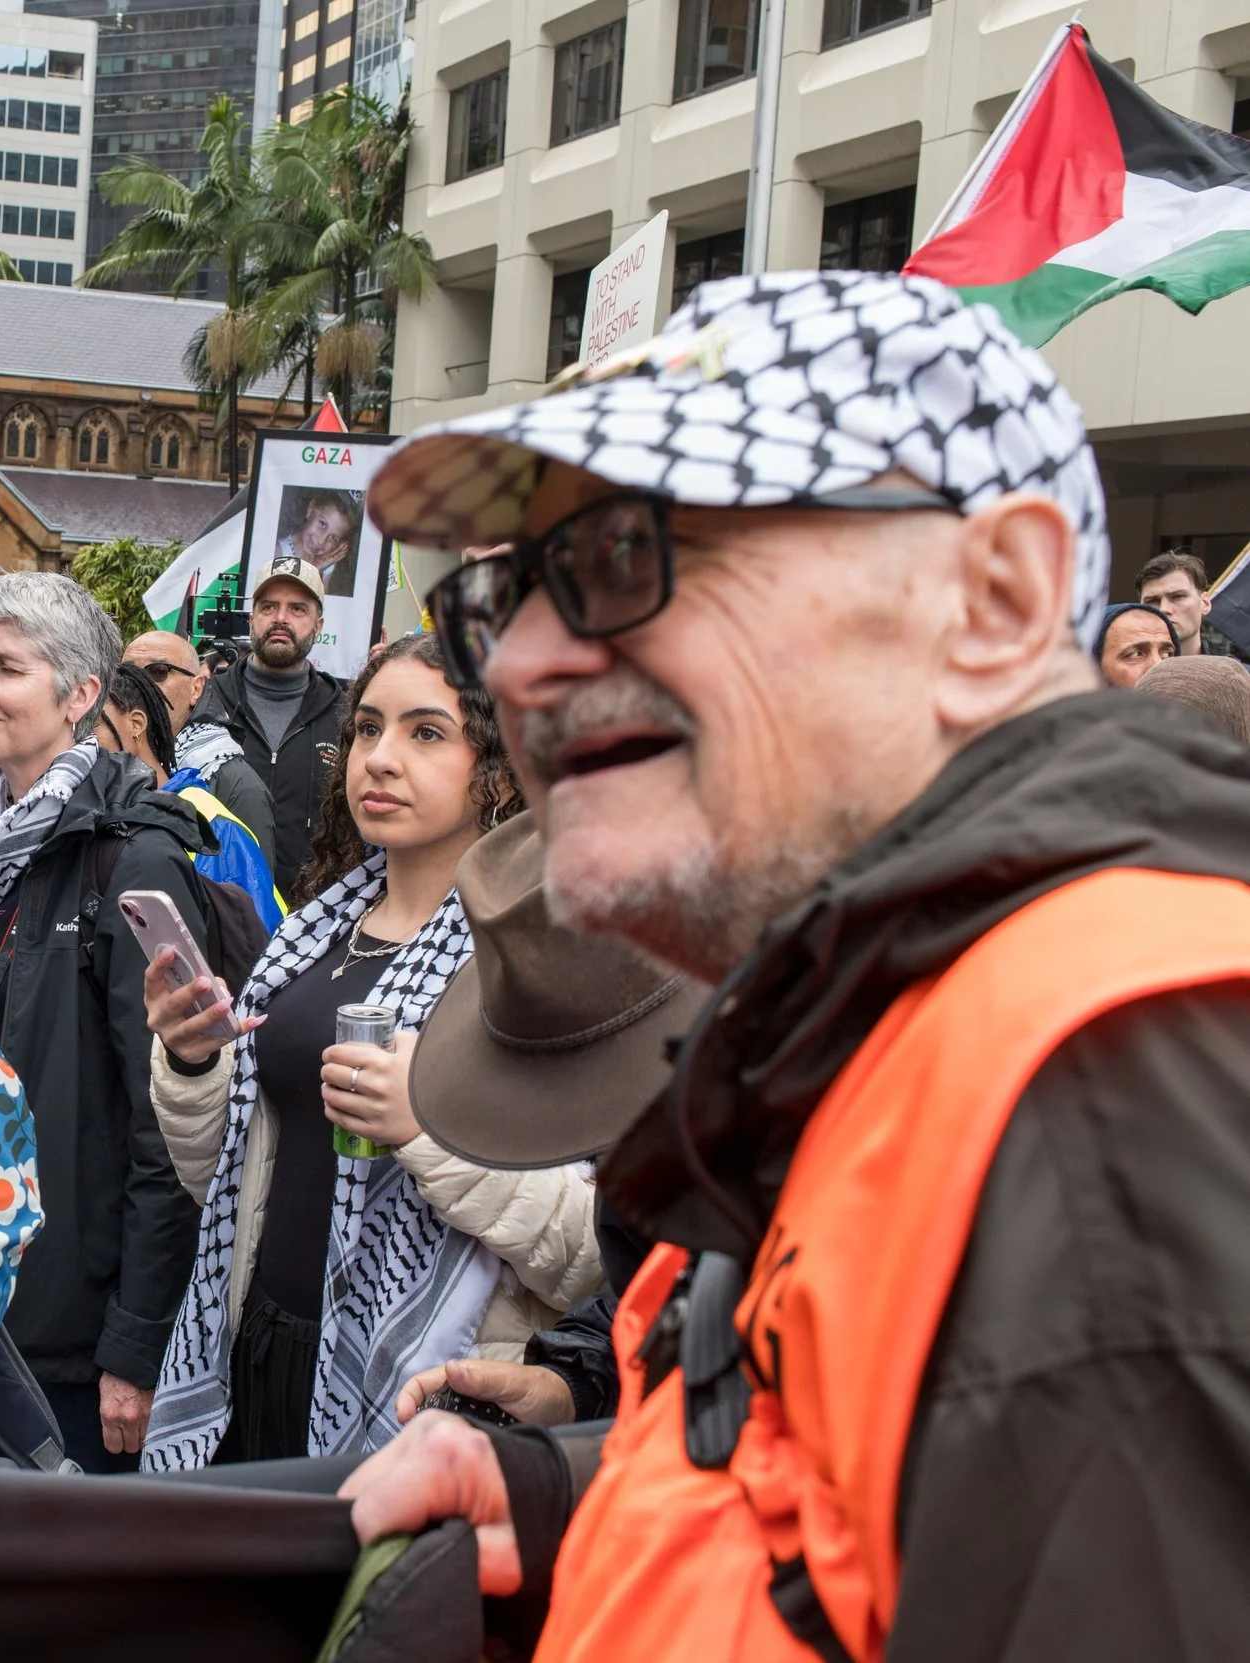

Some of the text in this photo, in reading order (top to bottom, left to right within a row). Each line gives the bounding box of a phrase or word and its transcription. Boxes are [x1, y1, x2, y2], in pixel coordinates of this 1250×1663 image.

[595, 244, 646, 302] TO STAND
[587, 300, 641, 360] PALESTINE
[591, 292, 617, 331] WITH
[301, 446, 352, 466] GAZA
